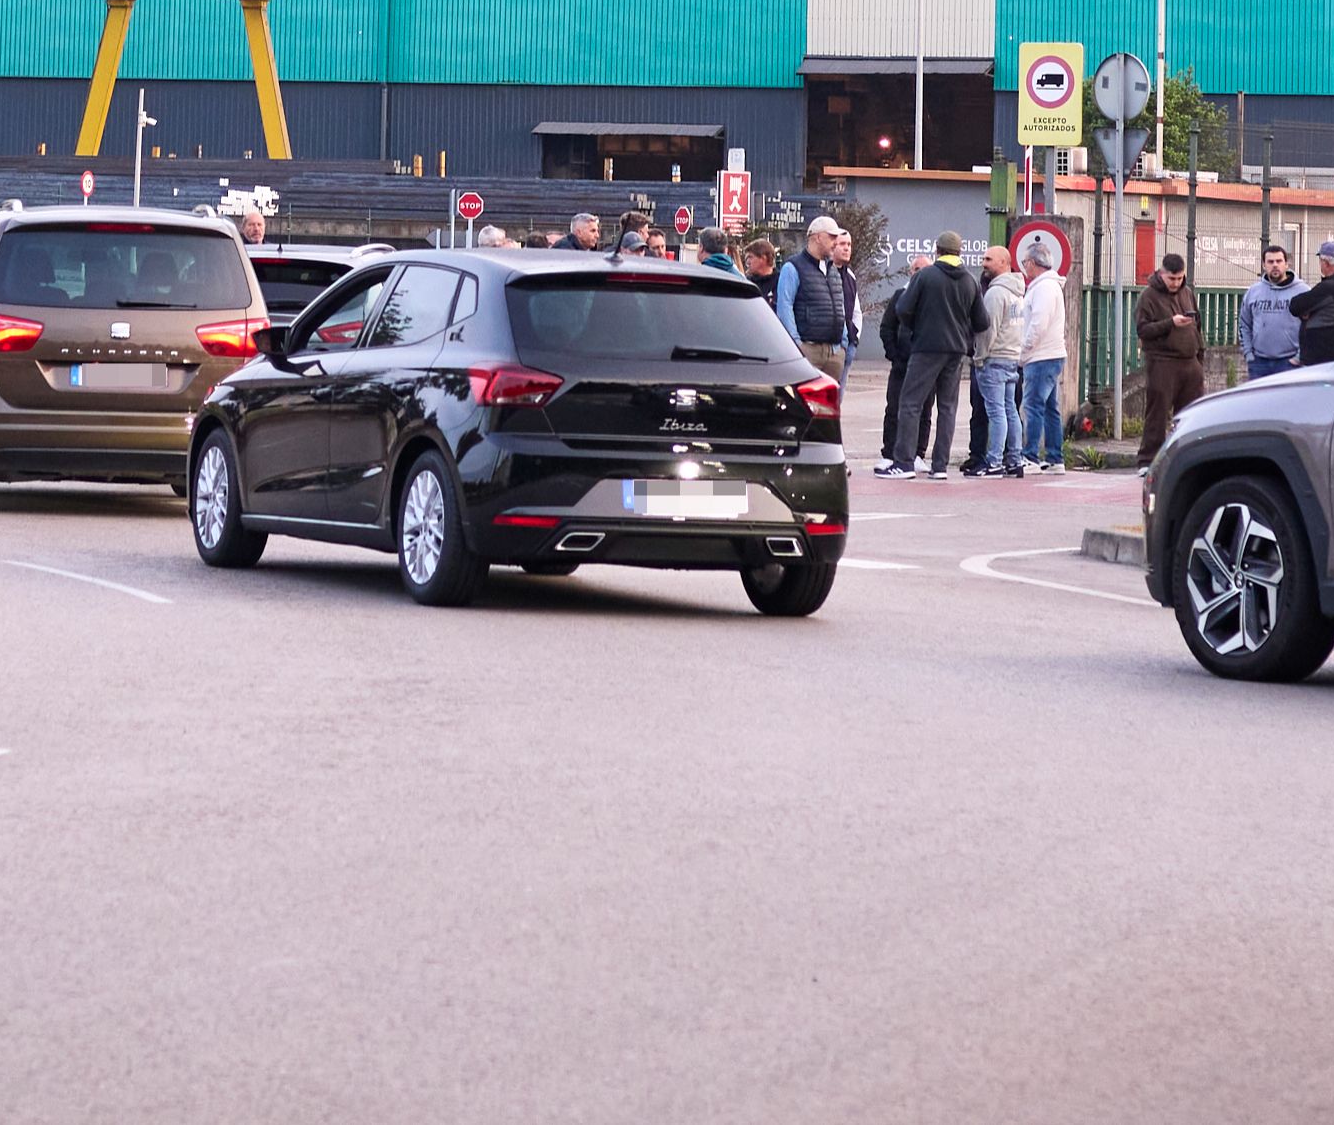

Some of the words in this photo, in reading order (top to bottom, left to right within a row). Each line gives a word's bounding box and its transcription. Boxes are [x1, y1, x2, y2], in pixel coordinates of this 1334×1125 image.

[459, 202, 481, 210] STOP
[676, 217, 689, 225] STOP
[960, 240, 988, 252] GLOB
[960, 254, 984, 266] STEE
[659, 418, 708, 432] Ibiza
